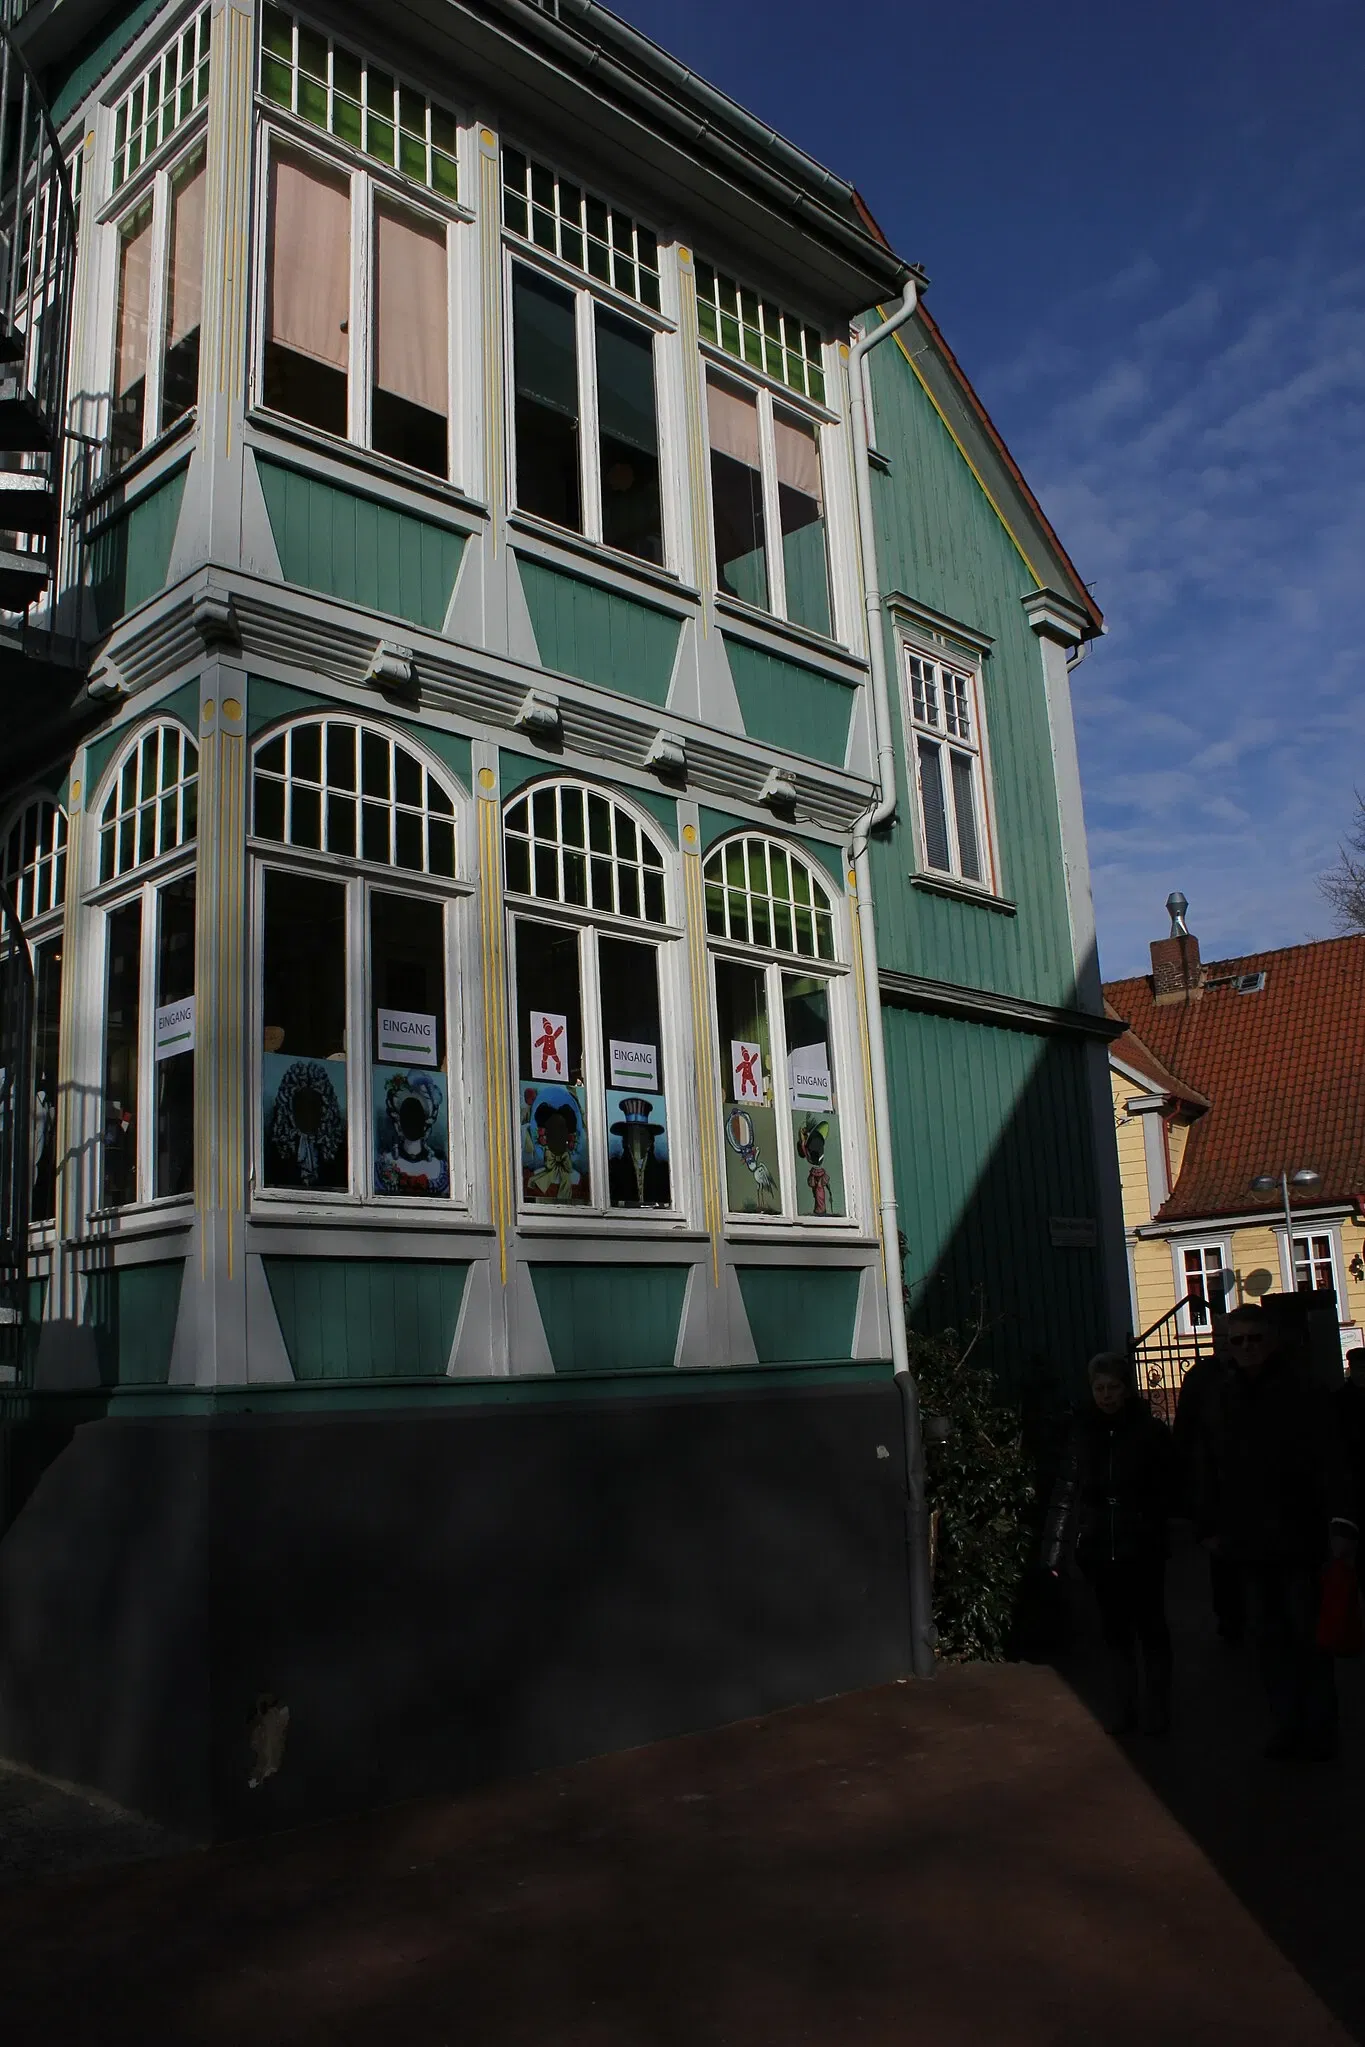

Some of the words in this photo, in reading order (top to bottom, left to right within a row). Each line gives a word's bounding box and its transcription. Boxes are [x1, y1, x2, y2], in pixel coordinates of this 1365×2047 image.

[159, 1007, 192, 1030] EINGANG
[383, 1019, 431, 1036] EINGANG
[614, 1049, 652, 1064] EINGANG
[796, 1074, 828, 1088] EINGANG
